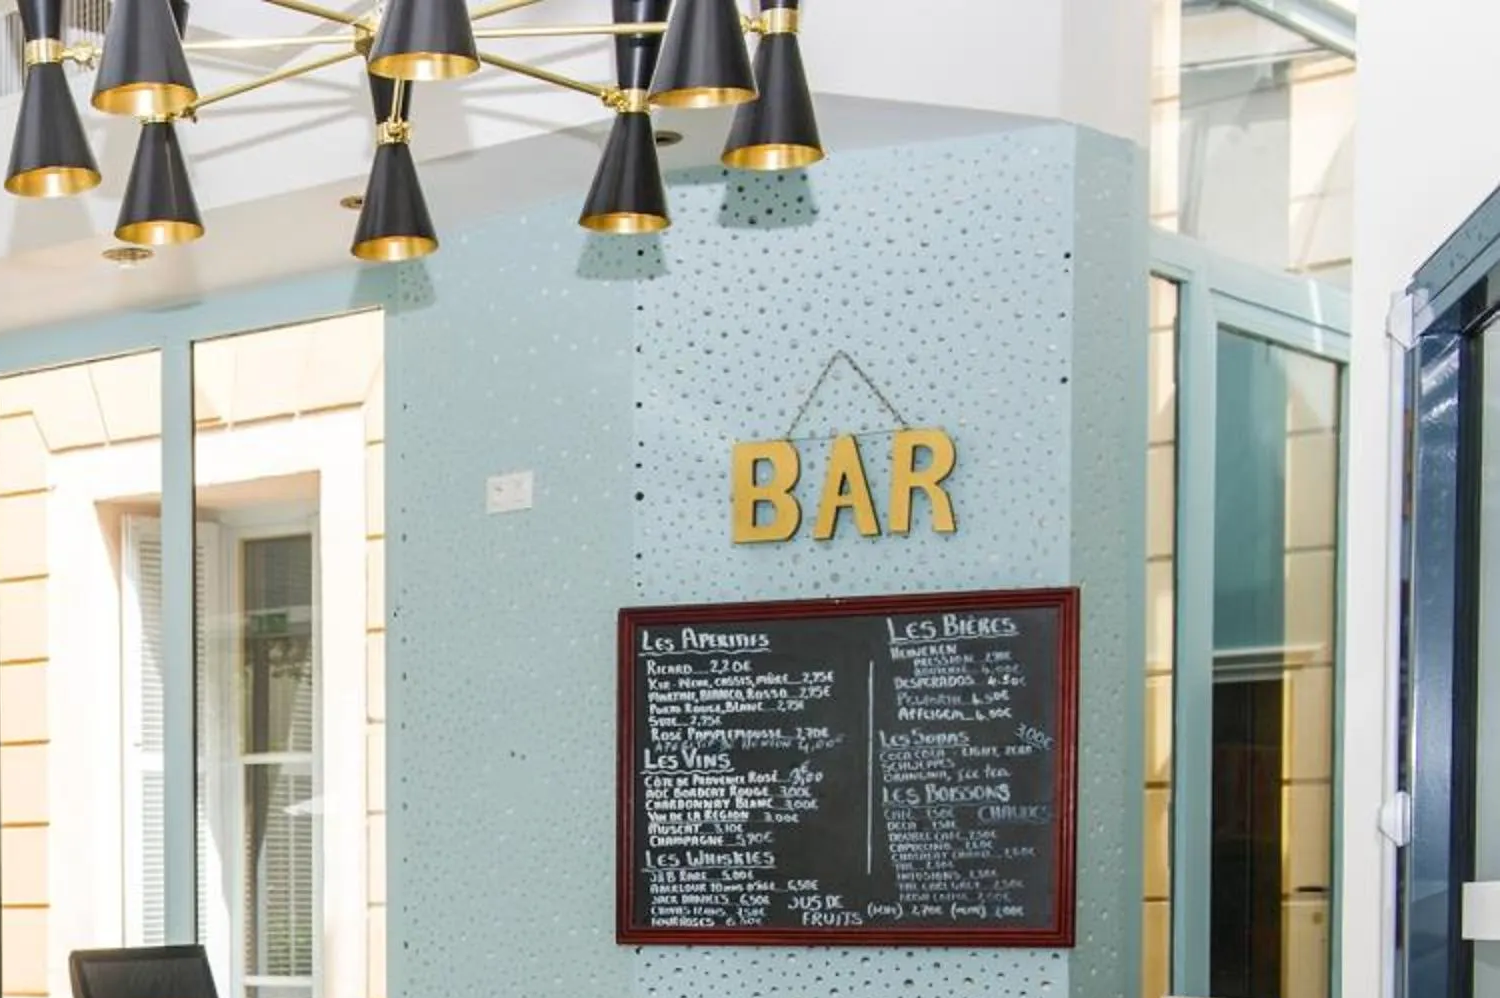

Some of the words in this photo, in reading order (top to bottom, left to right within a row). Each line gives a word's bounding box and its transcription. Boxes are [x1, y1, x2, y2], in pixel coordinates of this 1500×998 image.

[731, 428, 957, 544] BAR
[647, 659, 693, 675] RICARD
[924, 783, 1012, 803] BOISSONS
[650, 834, 725, 847] CHAMPAGNE
[787, 895, 822, 912] JUS
[801, 910, 864, 928] FRUITS
